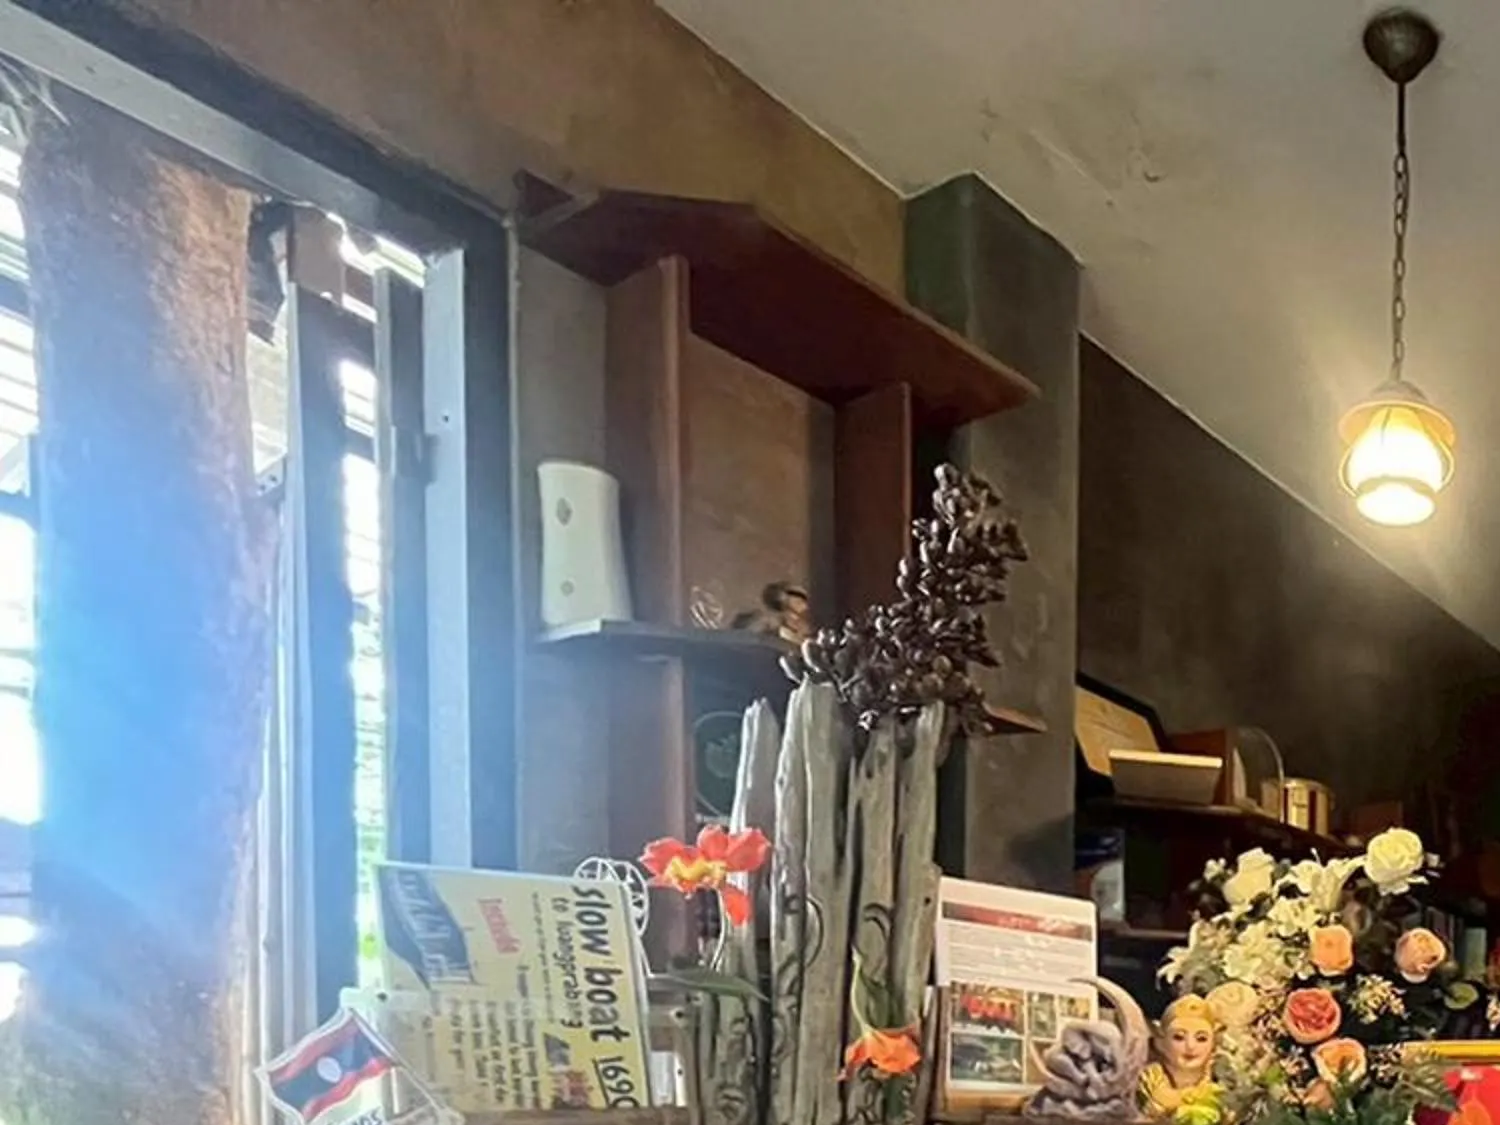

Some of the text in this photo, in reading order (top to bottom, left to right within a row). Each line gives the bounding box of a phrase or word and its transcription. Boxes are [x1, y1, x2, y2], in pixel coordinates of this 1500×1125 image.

[552, 895, 570, 912] to
[570, 885, 614, 957] slow
[583, 967, 629, 1044] boat
